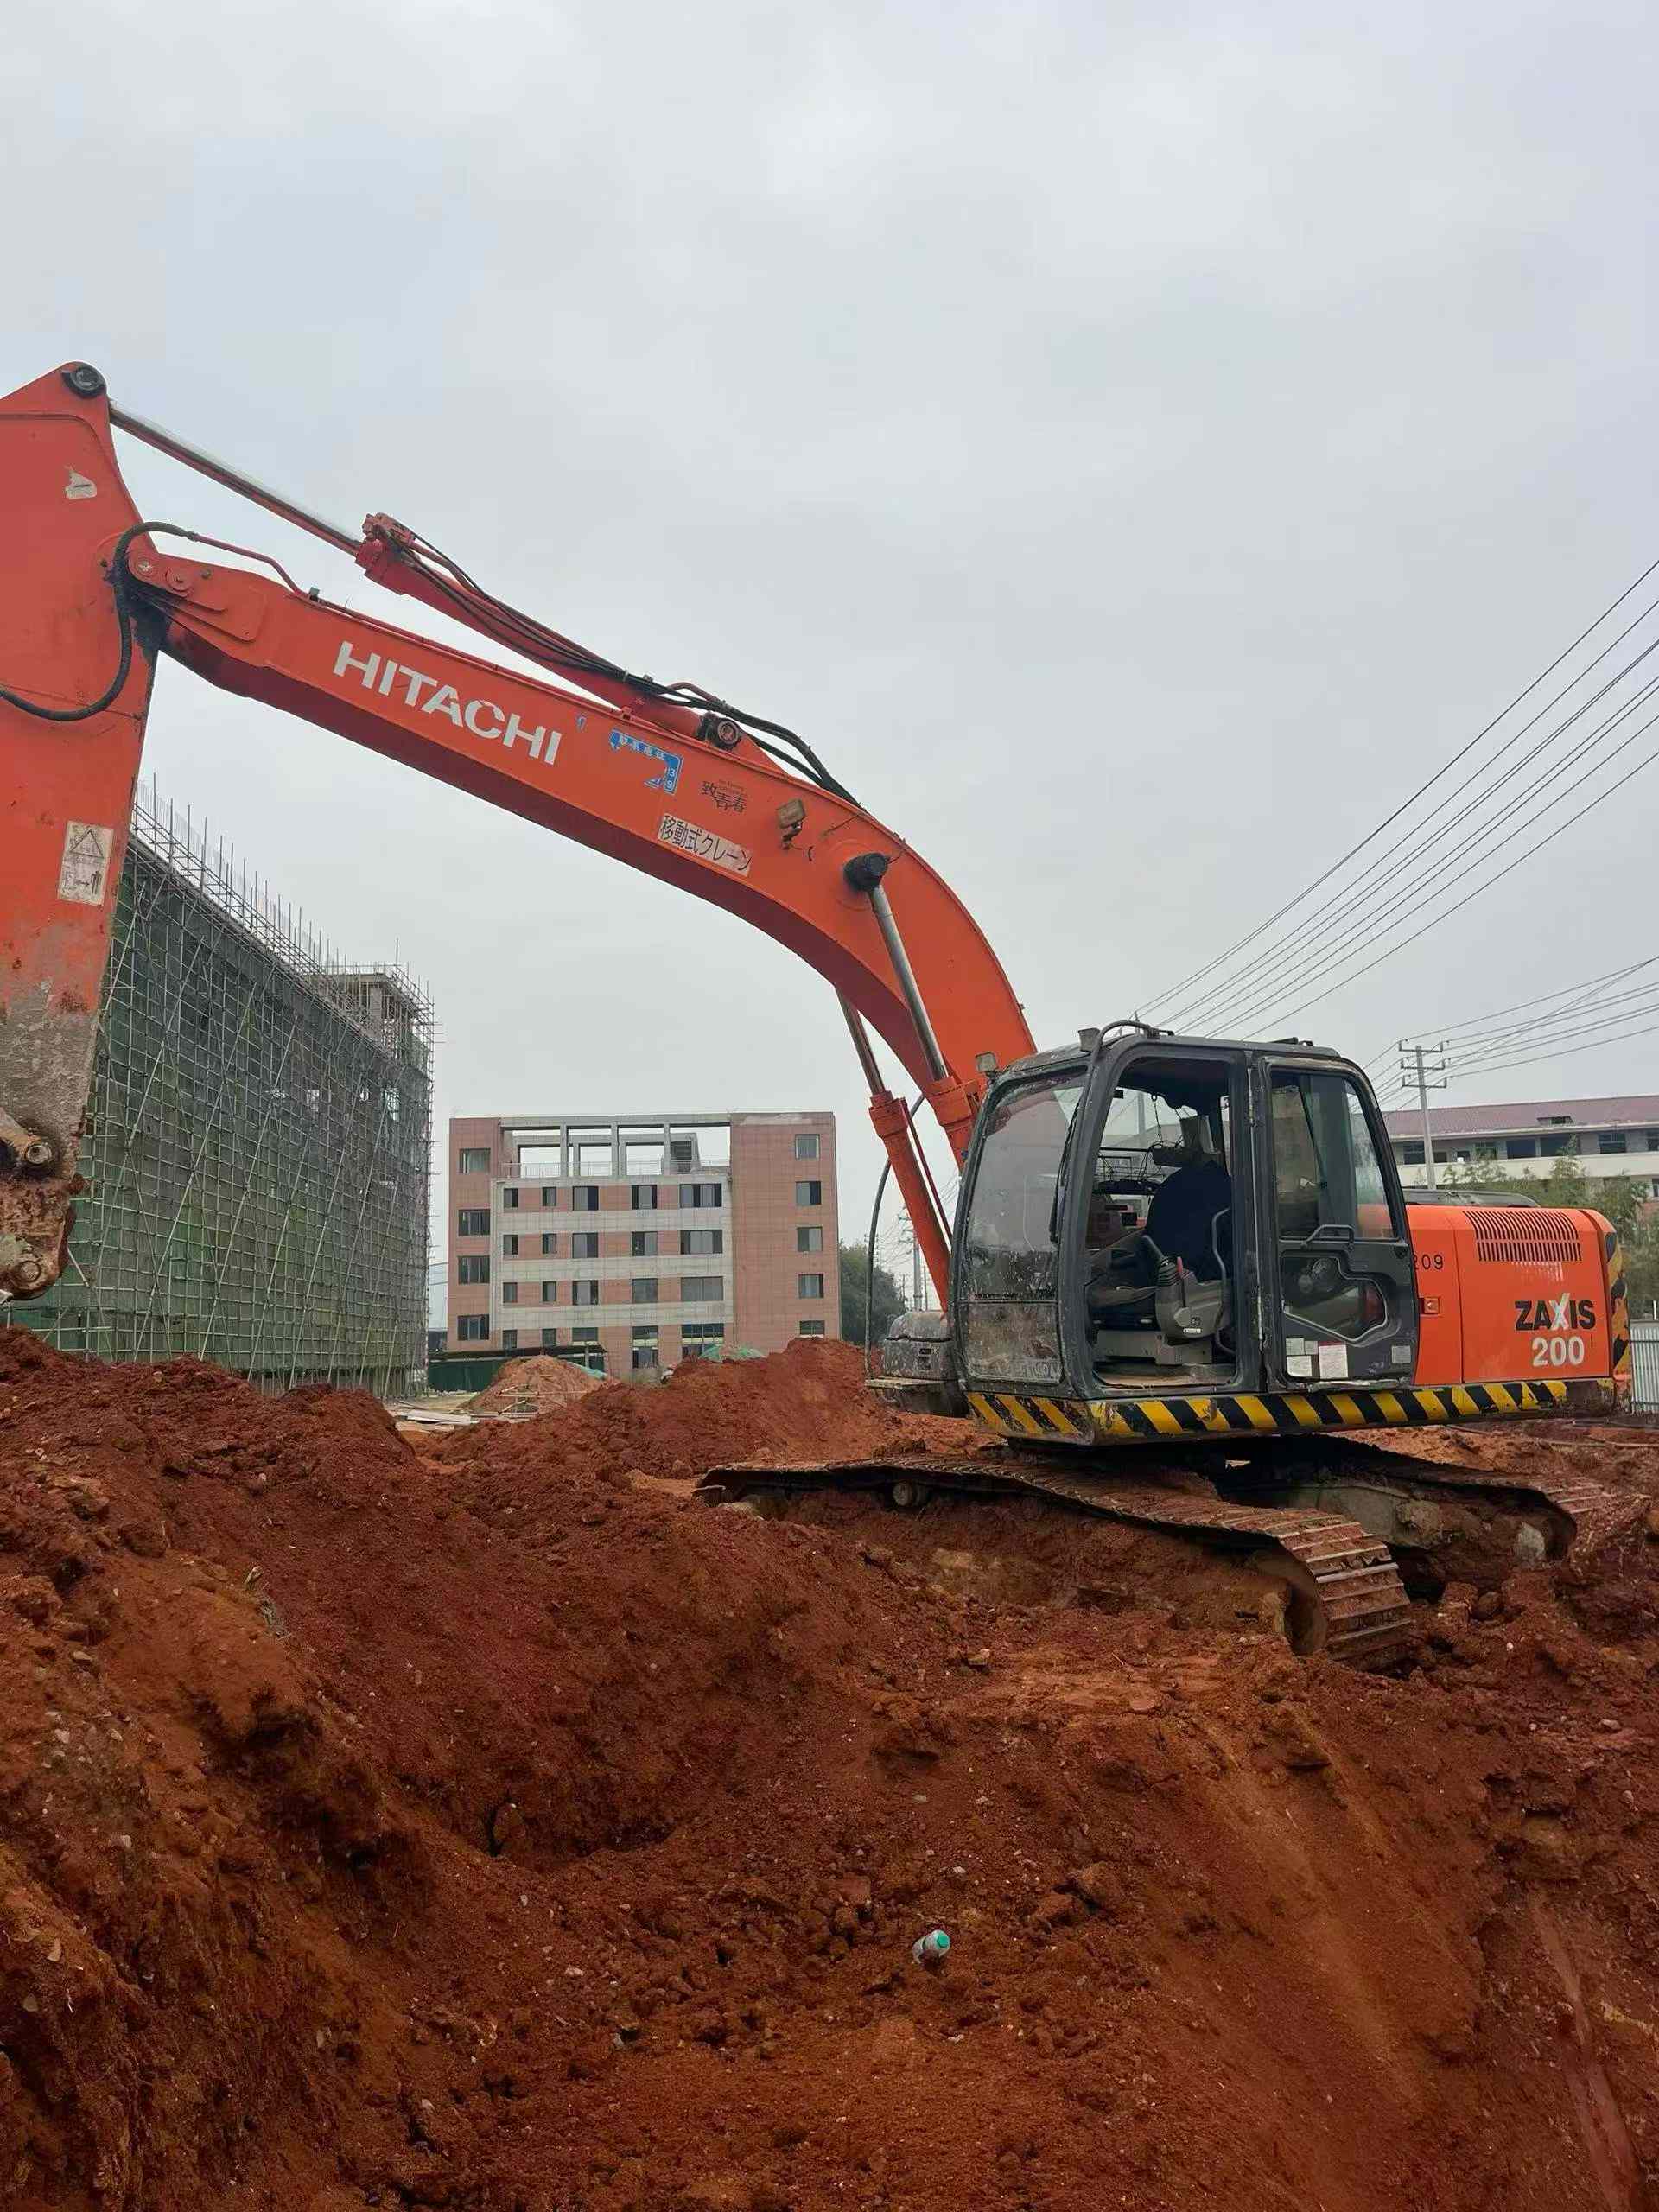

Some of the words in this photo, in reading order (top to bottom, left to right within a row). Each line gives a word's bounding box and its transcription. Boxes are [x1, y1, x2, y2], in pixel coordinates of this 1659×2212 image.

[333, 641, 562, 765] HITACHI
[661, 815, 753, 871] 移動式クレーン
[1515, 1293, 1596, 1331] ZAXIS
[1532, 1337, 1585, 1367] 200
